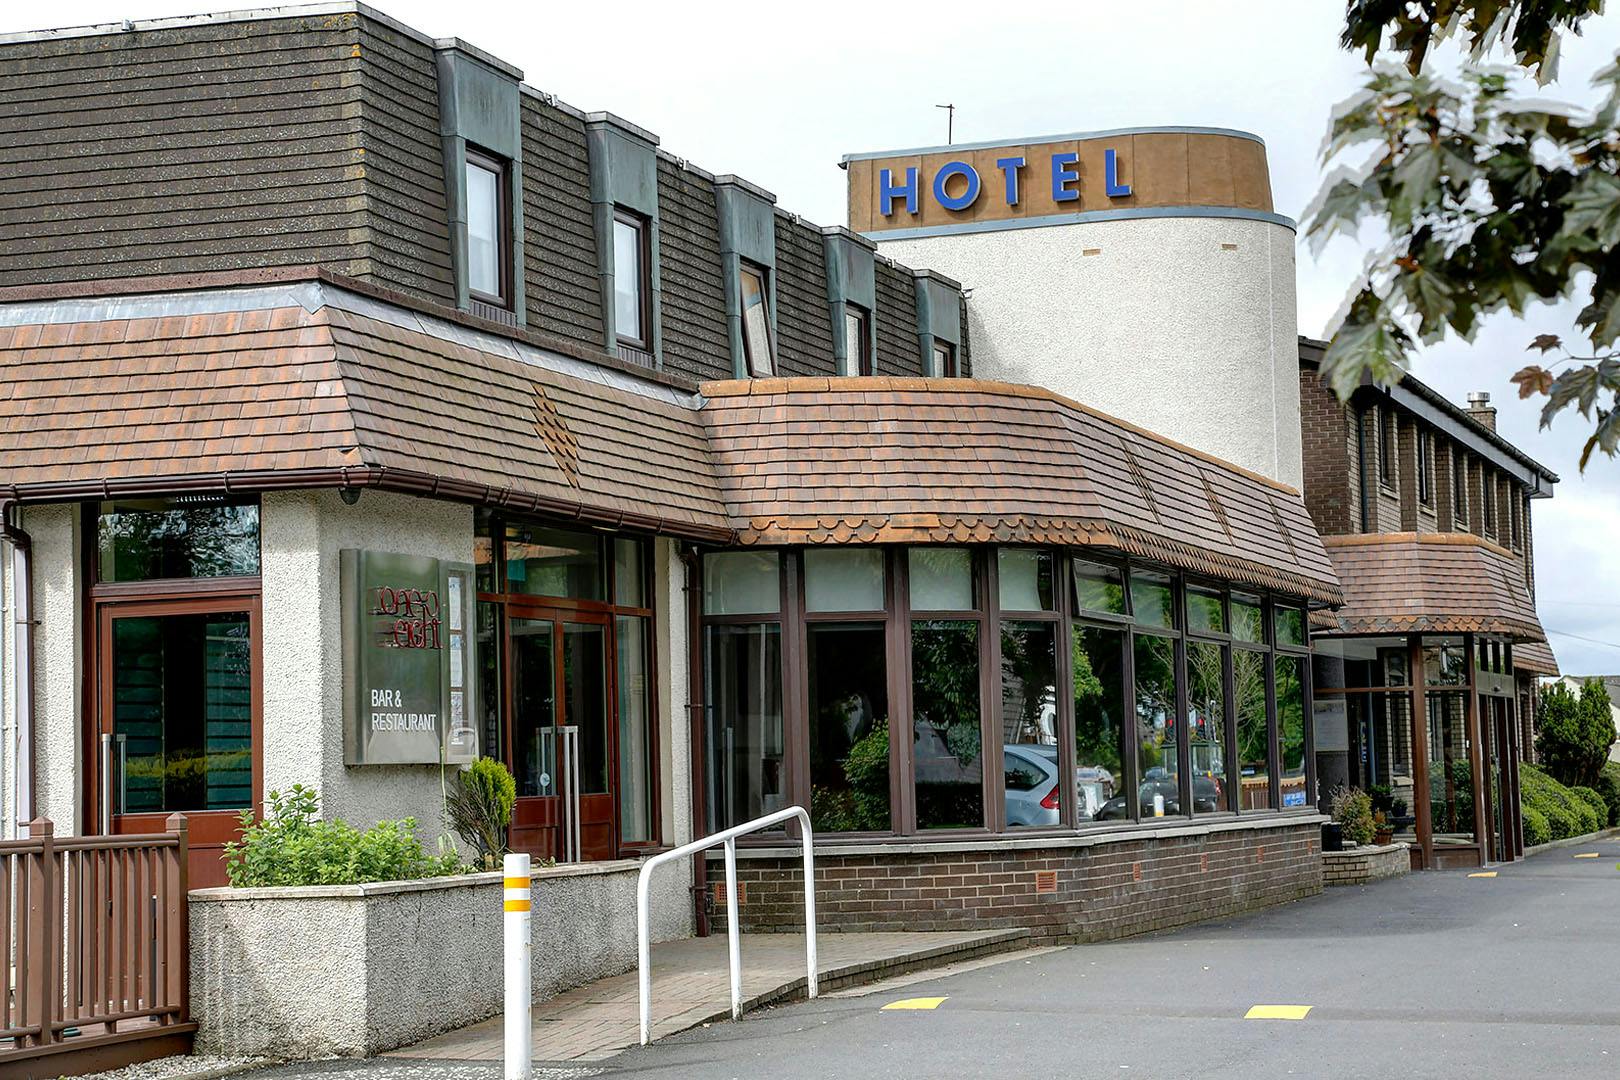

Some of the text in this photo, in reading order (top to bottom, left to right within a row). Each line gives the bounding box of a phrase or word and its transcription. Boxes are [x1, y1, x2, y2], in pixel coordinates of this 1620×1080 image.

[880, 149, 1132, 217] HOTEL
[371, 689, 402, 708] BAR &
[371, 713, 437, 731] RESTAURANT
